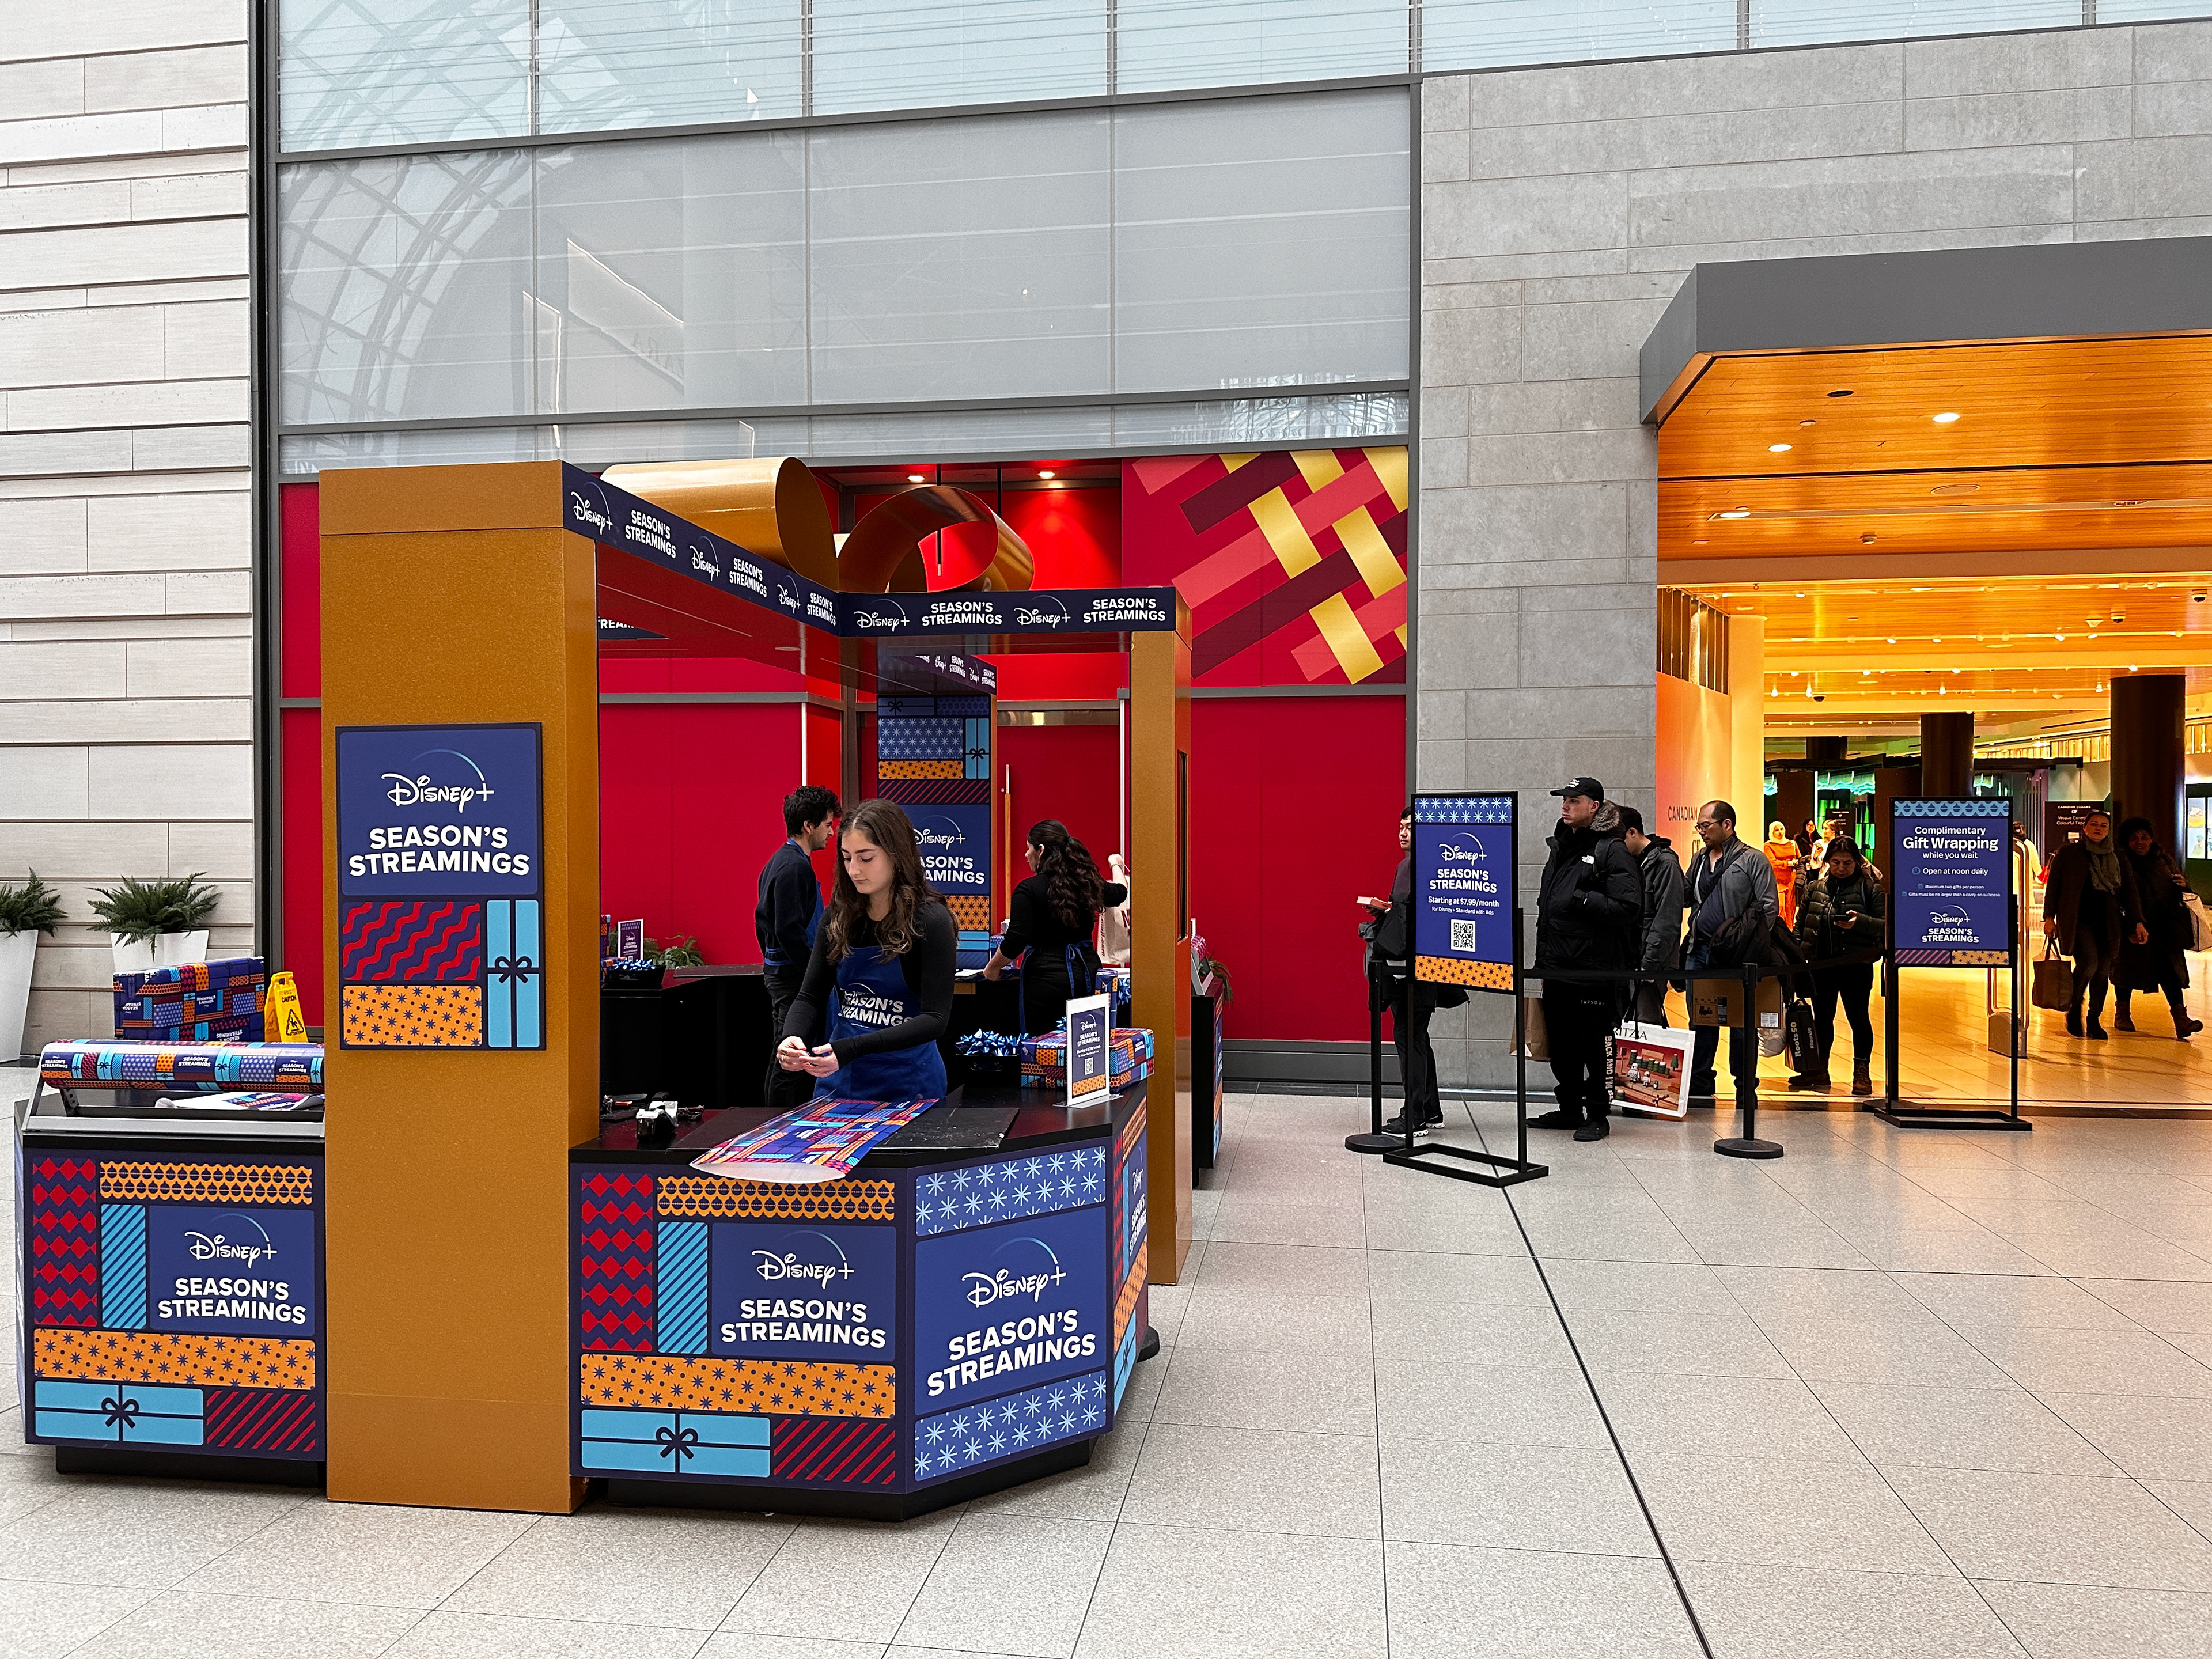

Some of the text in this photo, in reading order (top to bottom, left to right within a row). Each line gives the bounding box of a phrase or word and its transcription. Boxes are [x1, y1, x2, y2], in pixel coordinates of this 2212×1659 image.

[571, 491, 612, 535] Disney+
[631, 510, 671, 539] SEASON'S
[625, 525, 676, 559] STREAMINGS
[690, 545, 721, 581] Disney+
[733, 558, 763, 582] SEASON'S
[729, 571, 767, 598] STREAMINGS
[777, 584, 801, 614] Disney+
[810, 592, 833, 612] SEASON'S
[931, 602, 993, 613] SEASON'S
[1093, 598, 1157, 609] SEASON'S
[807, 604, 836, 627] STREAMINGS
[854, 611, 910, 632] Disney+
[922, 613, 1002, 627] STREAMINGS
[1014, 608, 1071, 629] Disney+
[1084, 610, 1166, 623] STREAMINGS
[381, 773, 495, 813] Disney+
[1668, 806, 1698, 821] CANADIAN
[369, 825, 508, 850] SEASON'S
[1915, 826, 1986, 836] Complimentary
[1439, 844, 1487, 866] Disney+
[1903, 836, 1999, 851] Gift Wrapping
[349, 850, 530, 877] STREAMINGS
[1437, 868, 1489, 881] SEASON'S
[1971, 868, 1988, 876] daily
[925, 870, 985, 884] AMINGS
[1429, 880, 1497, 893] STREAMINGS
[1428, 896, 1452, 906] Starting
[1460, 898, 1499, 907] $7.99/month
[1929, 912, 1971, 926] Disney+
[1922, 935, 1979, 943] STREAMINGS
[1605, 1036, 1613, 1057] BACK
[1790, 1022, 1802, 1058] Roots 50
[184, 1231, 278, 1269] Disney+
[751, 1249, 855, 1289] Disney+
[175, 1277, 289, 1300] SEASON'S
[961, 1264, 1067, 1308] Disney+
[158, 1299, 307, 1324] STREAMINGS
[740, 1299, 868, 1323] SEASON'S
[721, 1323, 887, 1349] STREAMINGS
[948, 1309, 1078, 1361] SEASON'S
[927, 1334, 1096, 1397] STREAMINGS
